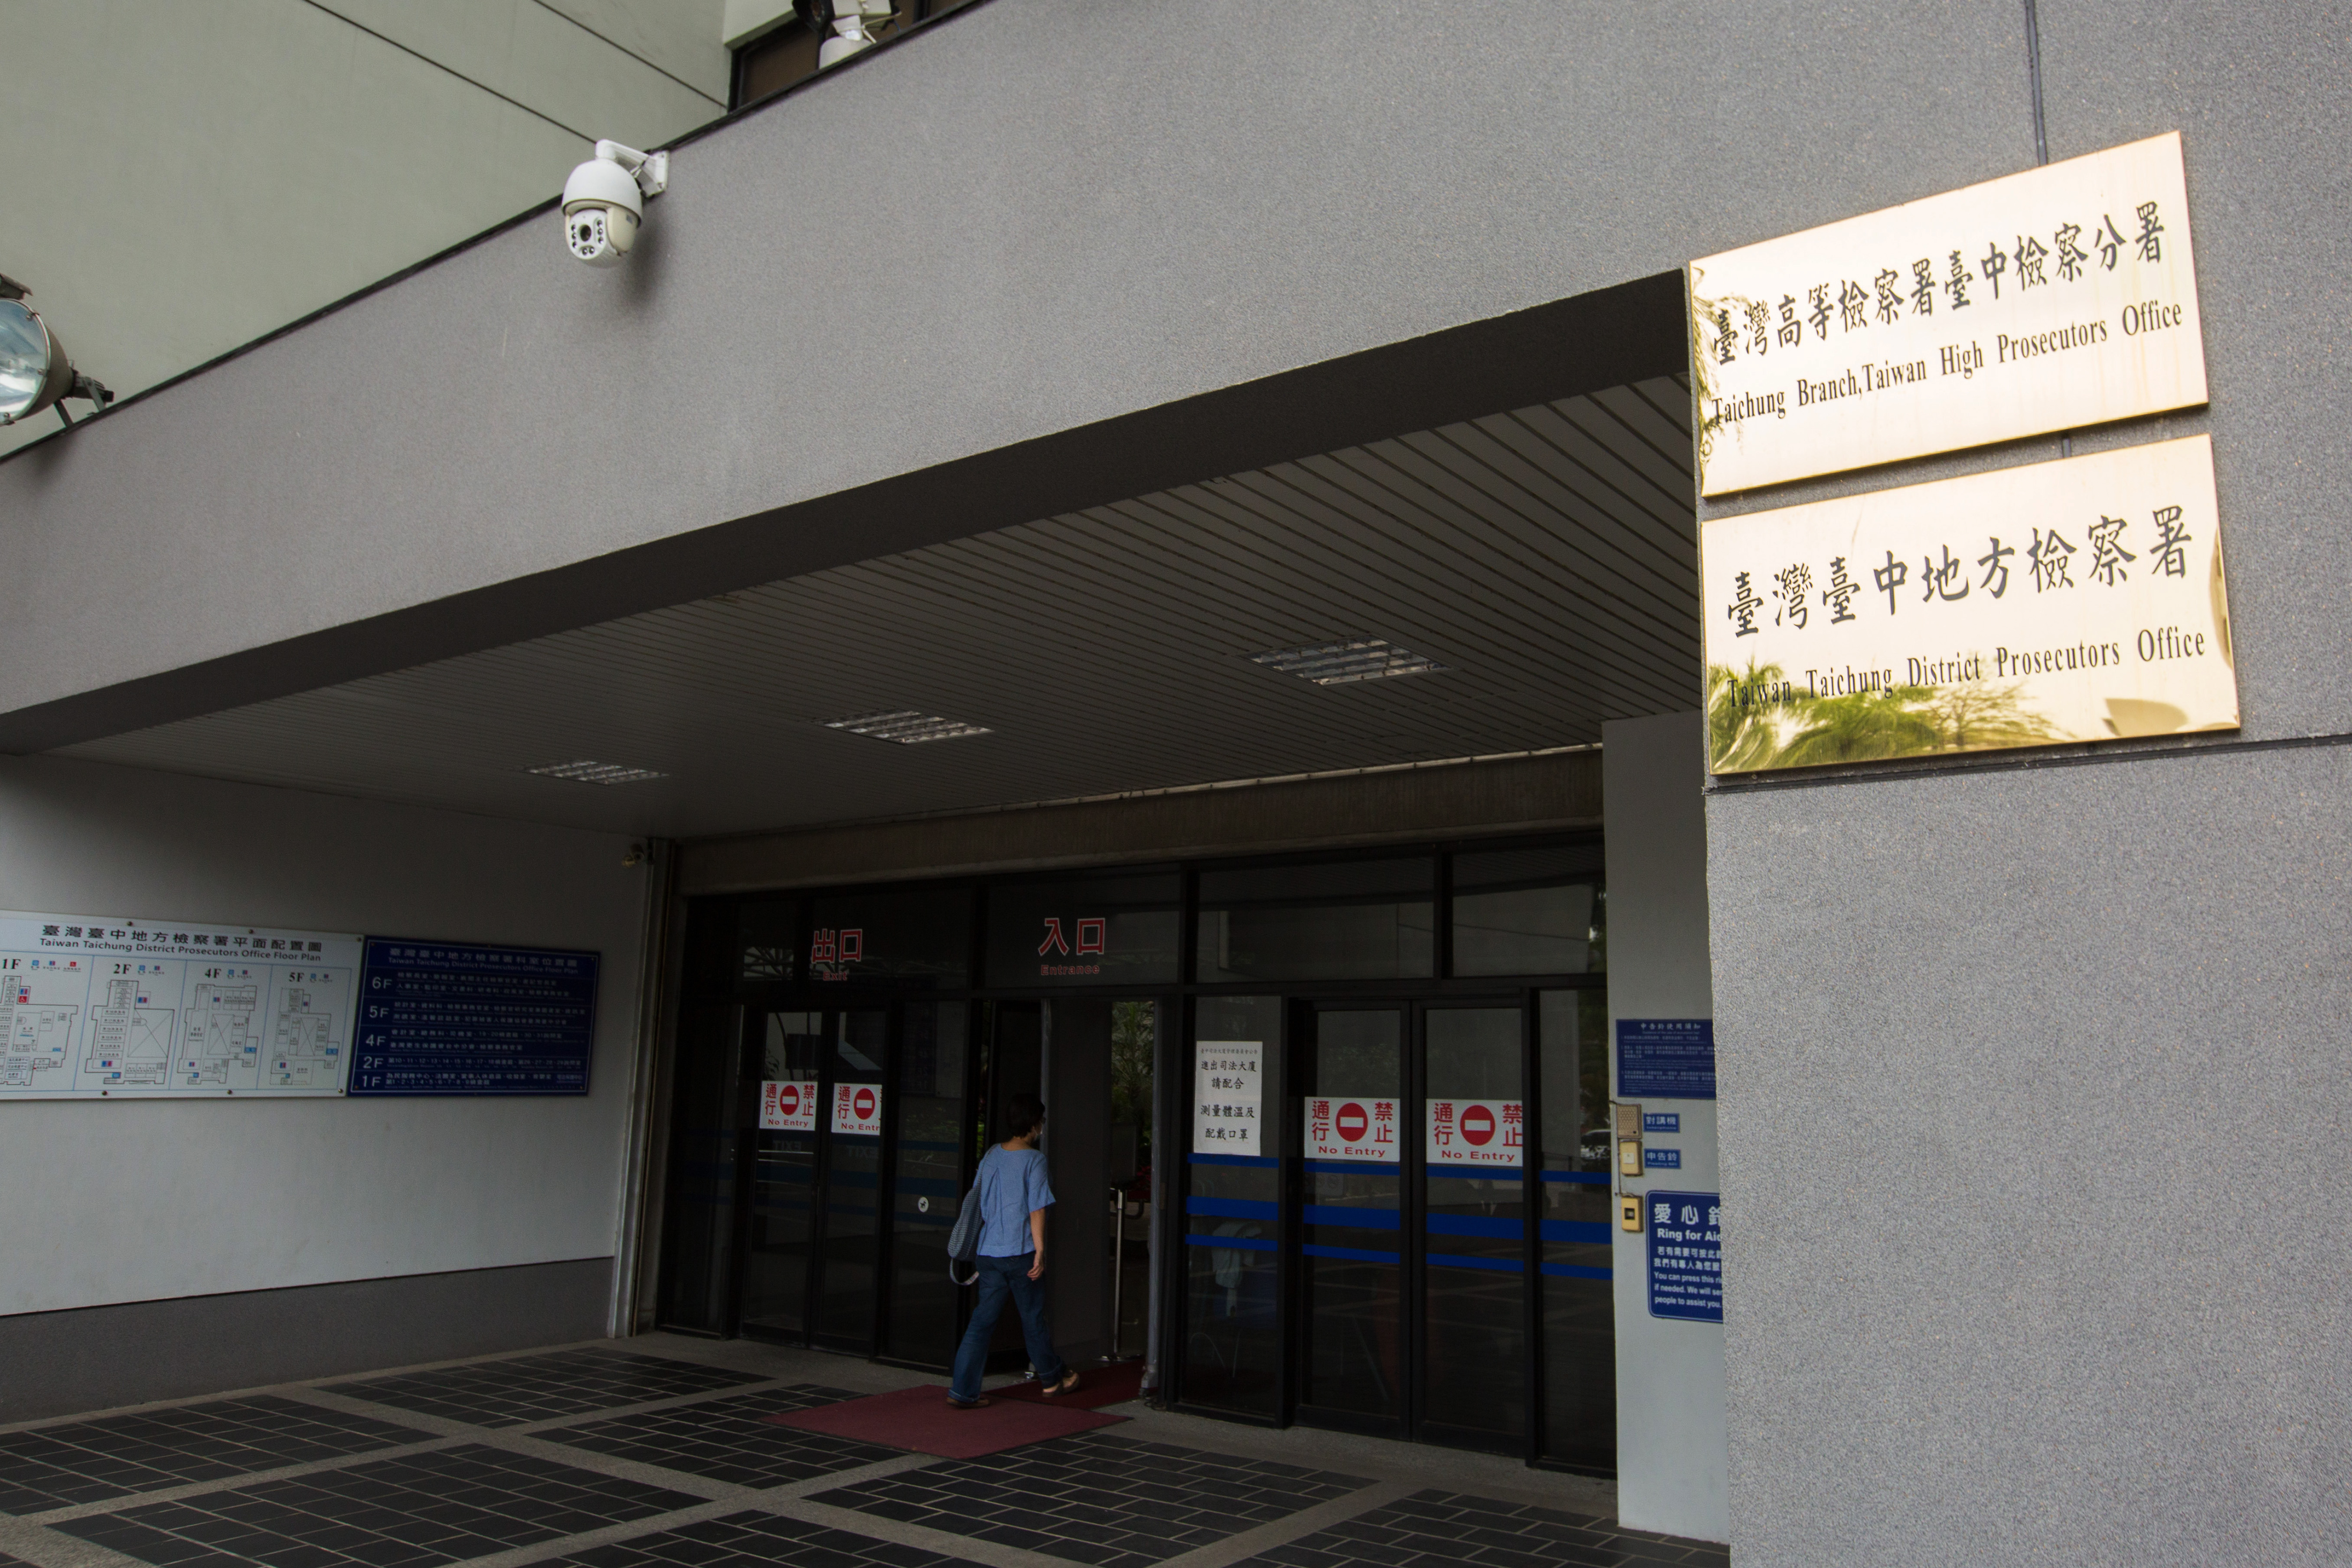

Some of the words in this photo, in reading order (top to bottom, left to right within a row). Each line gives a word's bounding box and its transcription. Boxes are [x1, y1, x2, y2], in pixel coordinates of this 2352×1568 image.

[1713, 201, 2165, 365] 臺灣高等檢察署臺中檢察分署
[1712, 389, 1786, 425] Taichung
[1940, 340, 1984, 379] High
[1997, 315, 2107, 364] Prosecutors
[2122, 301, 2182, 336] Office
[1728, 505, 2192, 638] 臺灣臺中地方檢察署
[1728, 676, 1791, 708] Taiwan
[1805, 666, 1893, 699] Taichung
[1908, 654, 1980, 685] District
[1996, 643, 2120, 681] Prosecutors
[2137, 627, 2205, 662] Office
[42, 925, 322, 952] 臺灣臺中地方檢察署平面配置圖
[1038, 918, 1105, 957] 入口
[40, 938, 79, 947] Taiwan
[83, 940, 132, 952] Taichung
[136, 943, 174, 953] District
[178, 946, 238, 957] Prosecutors
[242, 950, 271, 959] Office
[274, 951, 298, 960] Floor
[301, 954, 321, 962] Plan
[811, 928, 862, 964] 出口
[2, 958, 21, 970] 1F
[114, 964, 132, 974] 2F
[416, 959, 450, 968] Taichung
[480, 963, 521, 971] Prosecutors
[1041, 964, 1100, 975] Entrance
[205, 968, 222, 979] 4F
[289, 972, 305, 983] 5F
[823, 971, 847, 981] Exit
[372, 976, 392, 990] 6F
[369, 1005, 389, 1019] 5F
[366, 1034, 386, 1047] 4F
[363, 1055, 384, 1069] 2F
[1201, 1060, 1257, 1072] 進出司法大廈
[362, 1075, 382, 1088] 1F
[1211, 1077, 1245, 1089] 請配合
[765, 1083, 777, 1116] 通行
[802, 1084, 815, 1117] 禁止
[837, 1085, 851, 1120] 通行
[1200, 1104, 1255, 1118] 測量體溫及
[783, 1119, 809, 1128] Entry
[1311, 1100, 1330, 1142] 通行
[1374, 1101, 1394, 1143] 禁止
[1433, 1102, 1454, 1146] 通行
[1502, 1104, 1523, 1147] 禁止
[1205, 1127, 1248, 1141] 配戴口罩
[1318, 1146, 1338, 1154] No
[1344, 1147, 1385, 1158] Entry
[1441, 1150, 1463, 1159] No
[1470, 1151, 1515, 1163] Entry
[1647, 1152, 1677, 1161] 申告鈴
[1657, 1228, 1682, 1241] Ring
[1685, 1230, 1702, 1241] for
[1654, 1271, 1667, 1280] You
[1701, 1275, 1714, 1284] this
[1660, 1285, 1686, 1293] needed.
[1686, 1286, 1698, 1294] We
[1699, 1287, 1711, 1295] will
[1654, 1296, 1677, 1305] people
